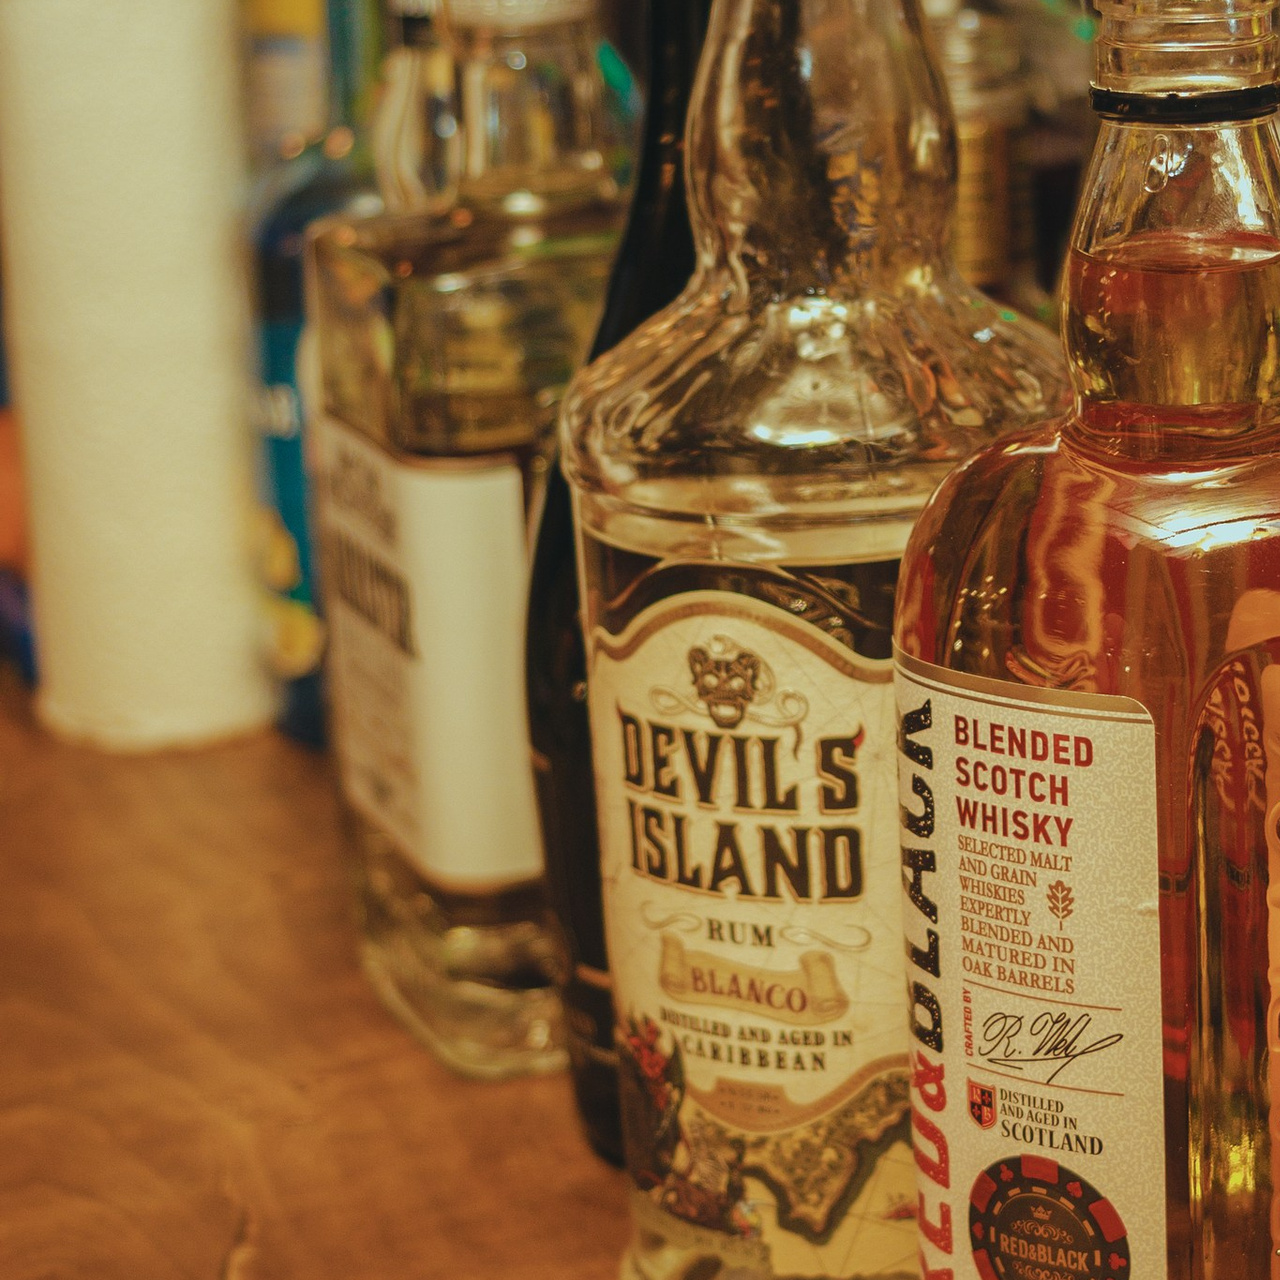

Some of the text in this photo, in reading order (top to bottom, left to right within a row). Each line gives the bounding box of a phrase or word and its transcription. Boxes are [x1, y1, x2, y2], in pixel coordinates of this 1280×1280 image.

[615, 696, 865, 815] DEVIL'S
[954, 715, 1094, 768] BLENDED
[956, 756, 1069, 807] SCOTCH
[956, 796, 1074, 848] WHISKY
[627, 796, 864, 904] ISLAND
[958, 834, 1072, 872] SELECTED MALT
[959, 855, 1037, 887] AND GRAIN
[959, 875, 1025, 905] WHISKIES
[960, 895, 1031, 927] EXPERTLY
[707, 918, 775, 948] RUM
[961, 915, 1074, 954] BLENDED AND
[961, 935, 1075, 975] MATURED IN
[691, 966, 808, 1013] BLANCO
[962, 956, 1075, 995] OAK BARRELS
[738, 1025, 771, 1044] AND
[779, 1030, 825, 1046] AGED
[832, 1030, 853, 1046] IN
[962, 987, 974, 1057] CRAFTED BY
[682, 1034, 827, 1072] CARIBBEAN
[1000, 1088, 1064, 1113] DISTILLED
[1000, 1103, 1077, 1130] AND AGED IN
[1001, 1119, 1103, 1156] SCOTLAND
[1000, 1233, 1089, 1272] RED&BLACK
